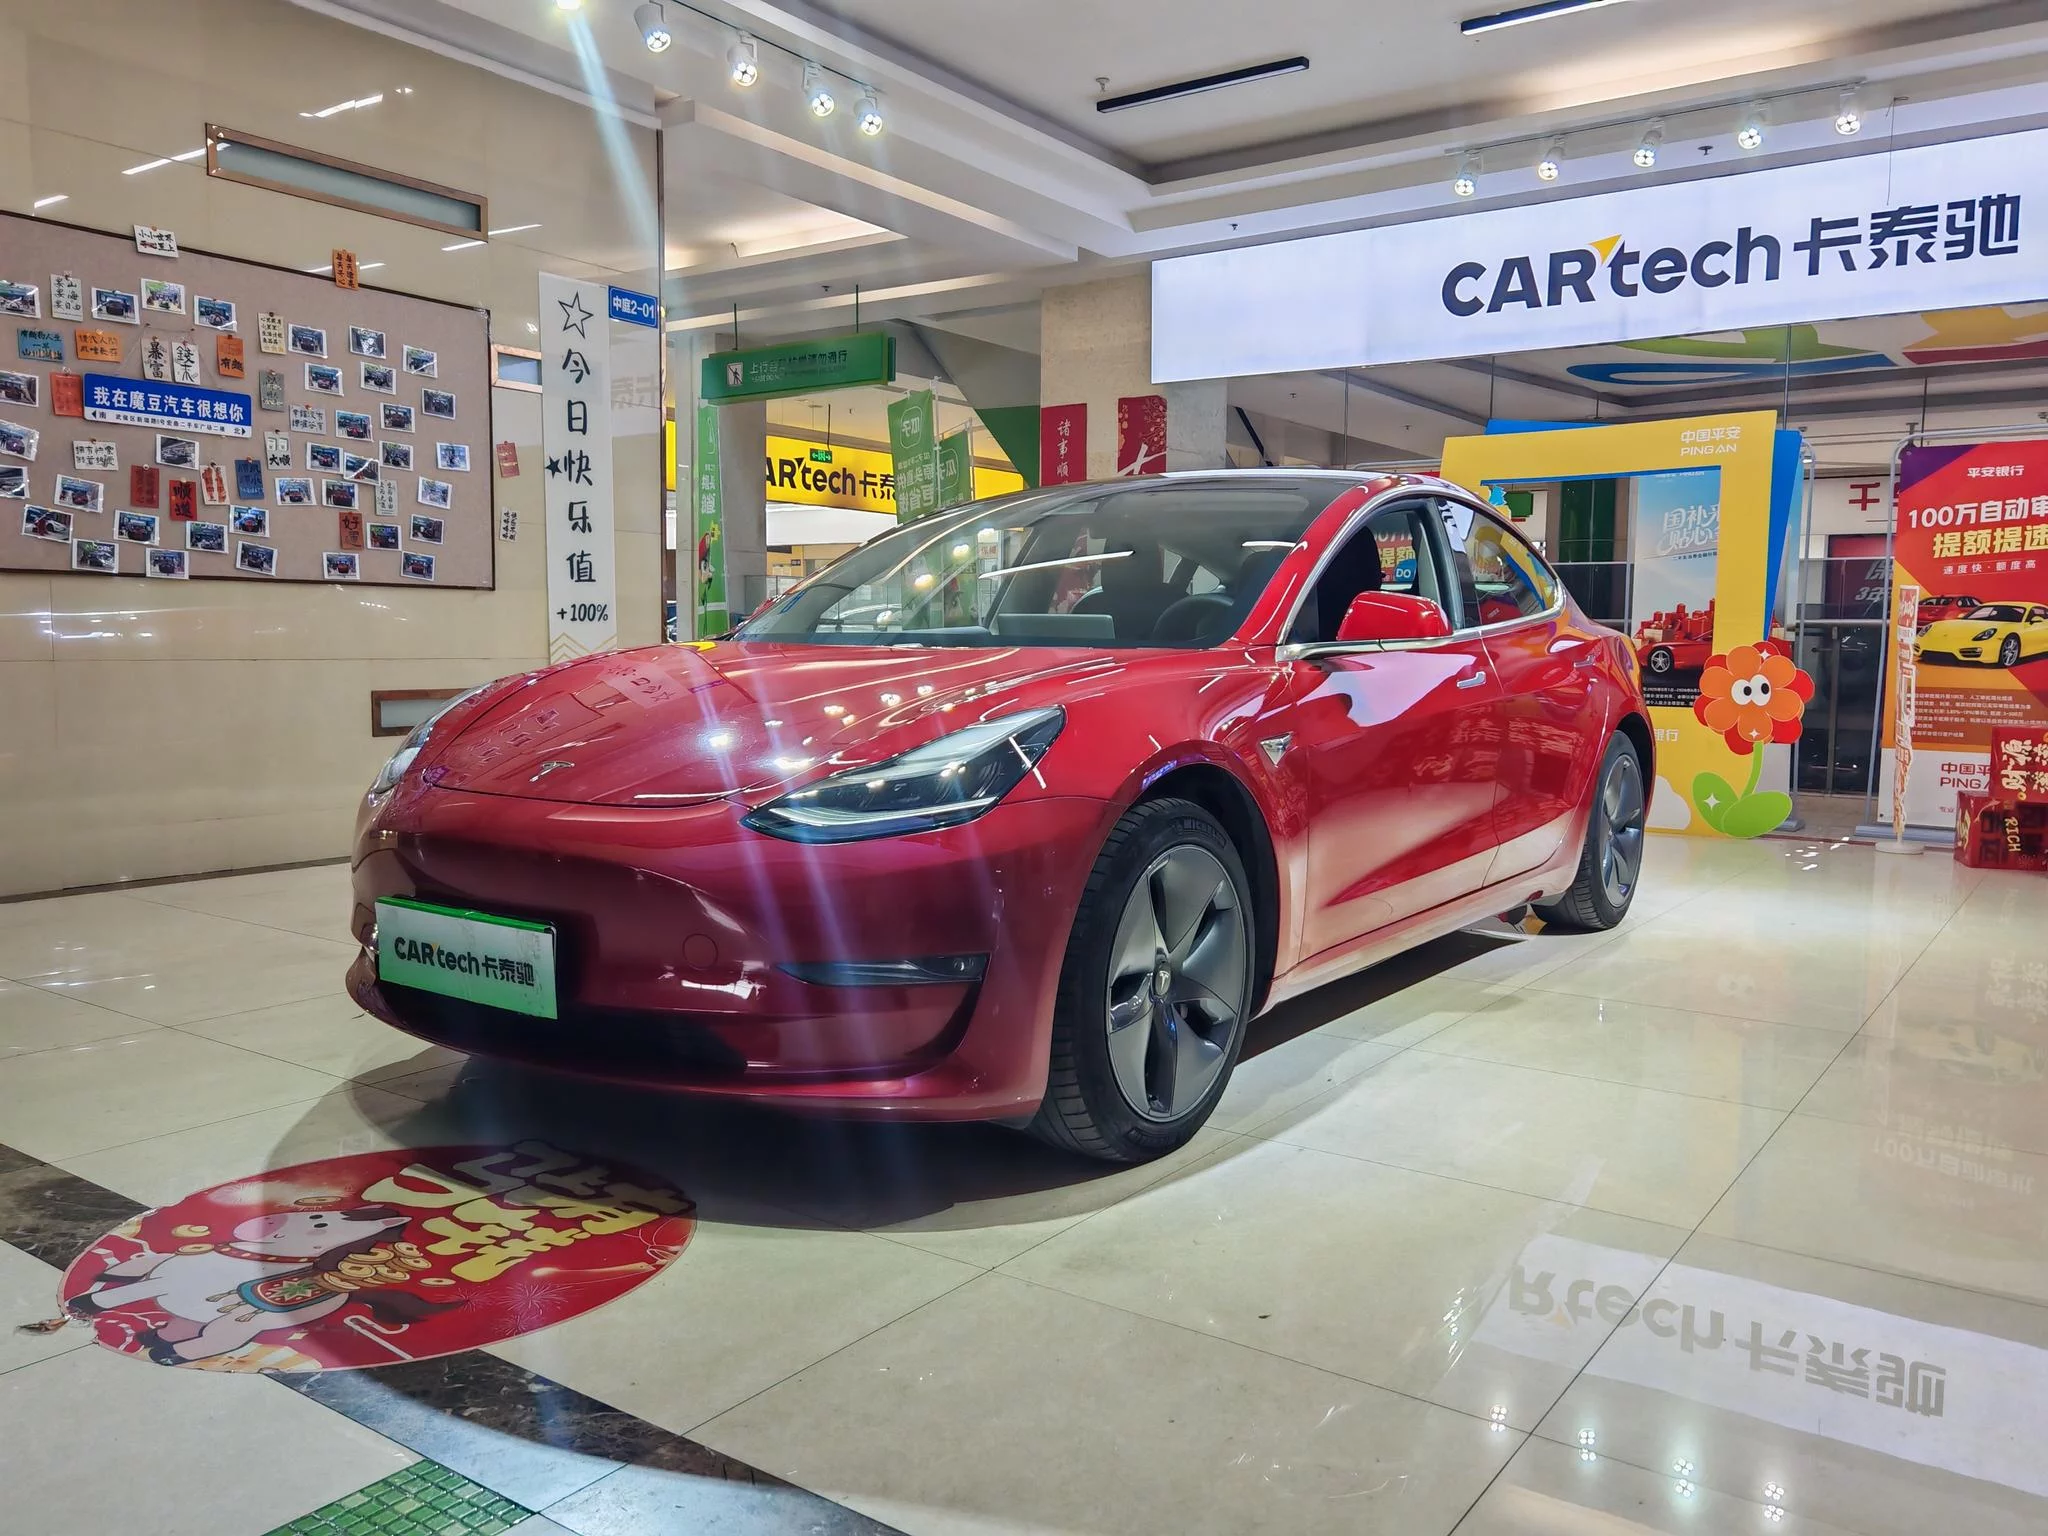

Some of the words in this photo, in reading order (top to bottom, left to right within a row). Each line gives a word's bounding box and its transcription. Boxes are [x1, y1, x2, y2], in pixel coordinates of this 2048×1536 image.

[1441, 225, 1781, 317] CARtech
[1794, 193, 2021, 276] 卡泰驰
[612, 294, 656, 320] 中庭2-01
[93, 386, 244, 423] 我在魔豆汽车很想你
[1056, 419, 1072, 484] 诸事顺
[1681, 426, 1741, 443] 中国平安
[561, 347, 597, 584] 今日快乐值
[1967, 465, 2025, 478] 平安银行
[1933, 523, 2048, 559] 提额提速
[556, 603, 609, 623] +100%
[2004, 815, 2022, 853] RICH
[394, 936, 480, 976] CARtech
[481, 954, 535, 987] 卡泰驰
